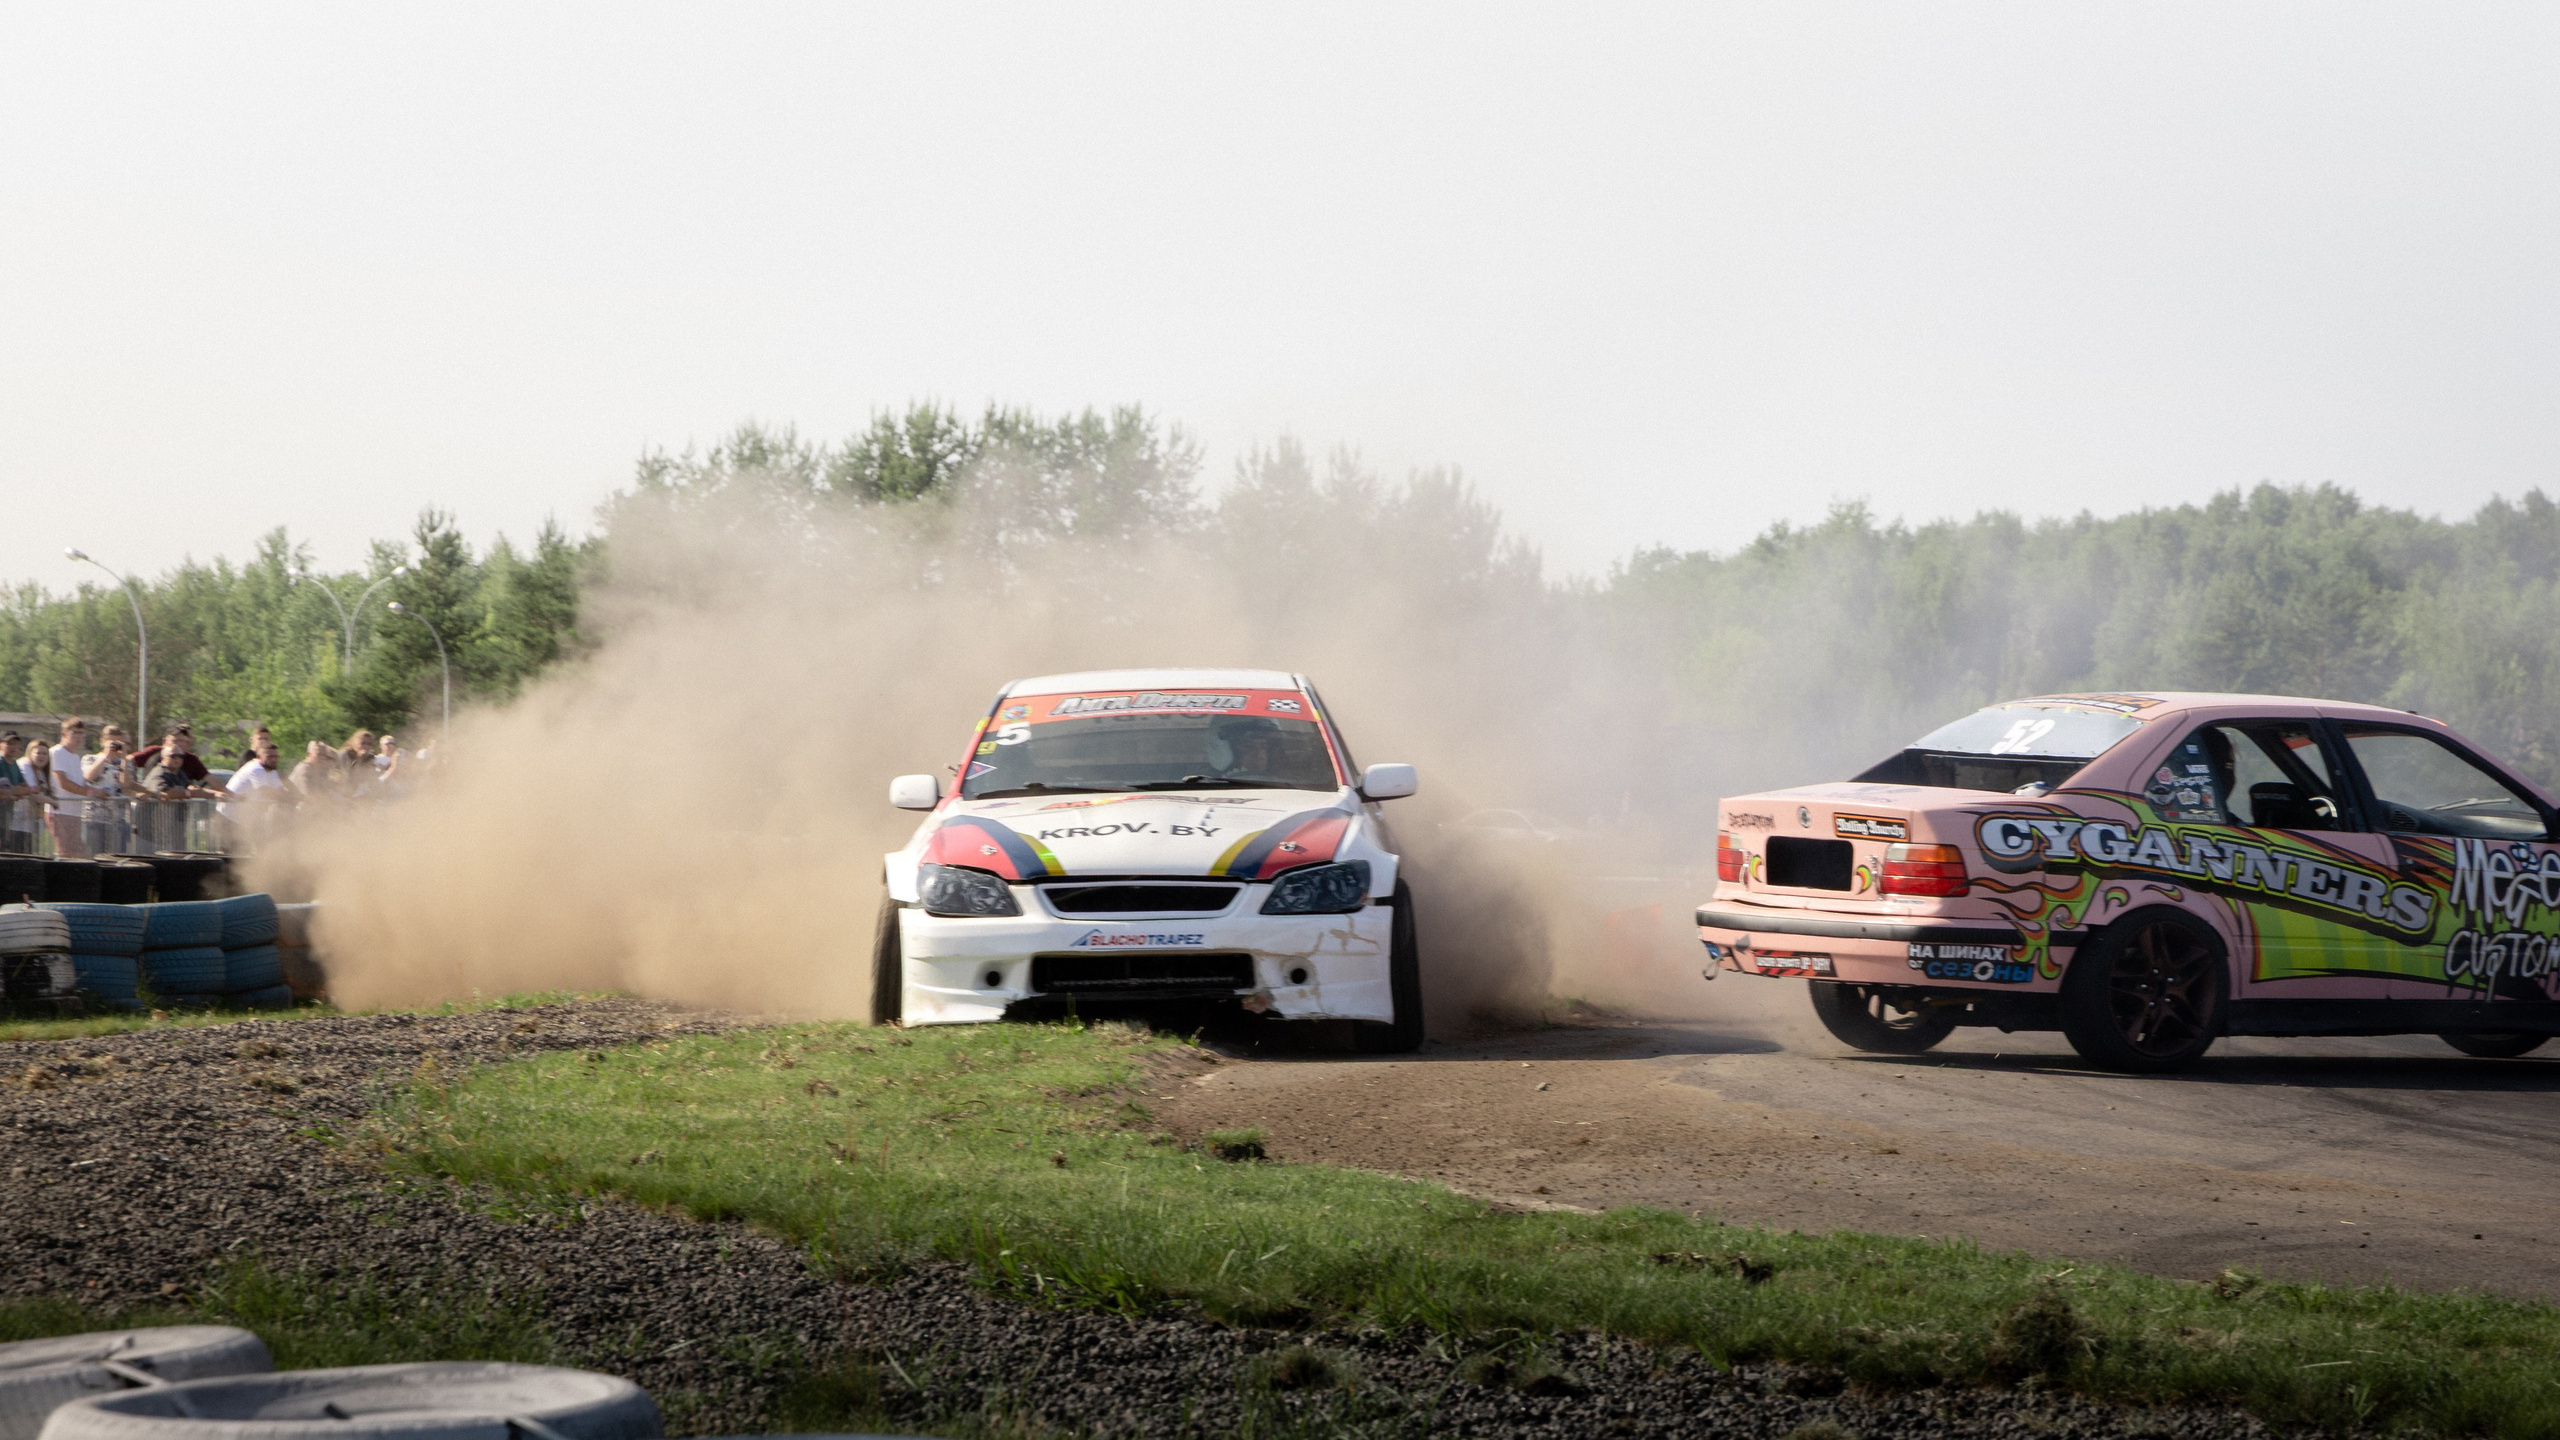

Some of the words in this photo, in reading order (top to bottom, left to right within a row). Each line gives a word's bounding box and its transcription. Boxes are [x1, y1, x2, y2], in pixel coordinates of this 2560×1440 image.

[995, 722, 1032, 746] 5
[1990, 718, 2056, 755] 52
[1979, 817, 2433, 931] CYGANNERS
[1090, 933, 1204, 946] BLACHOTRAPEZ
[1909, 943, 1935, 958] НА
[1938, 945, 2005, 960] ШИНАХ
